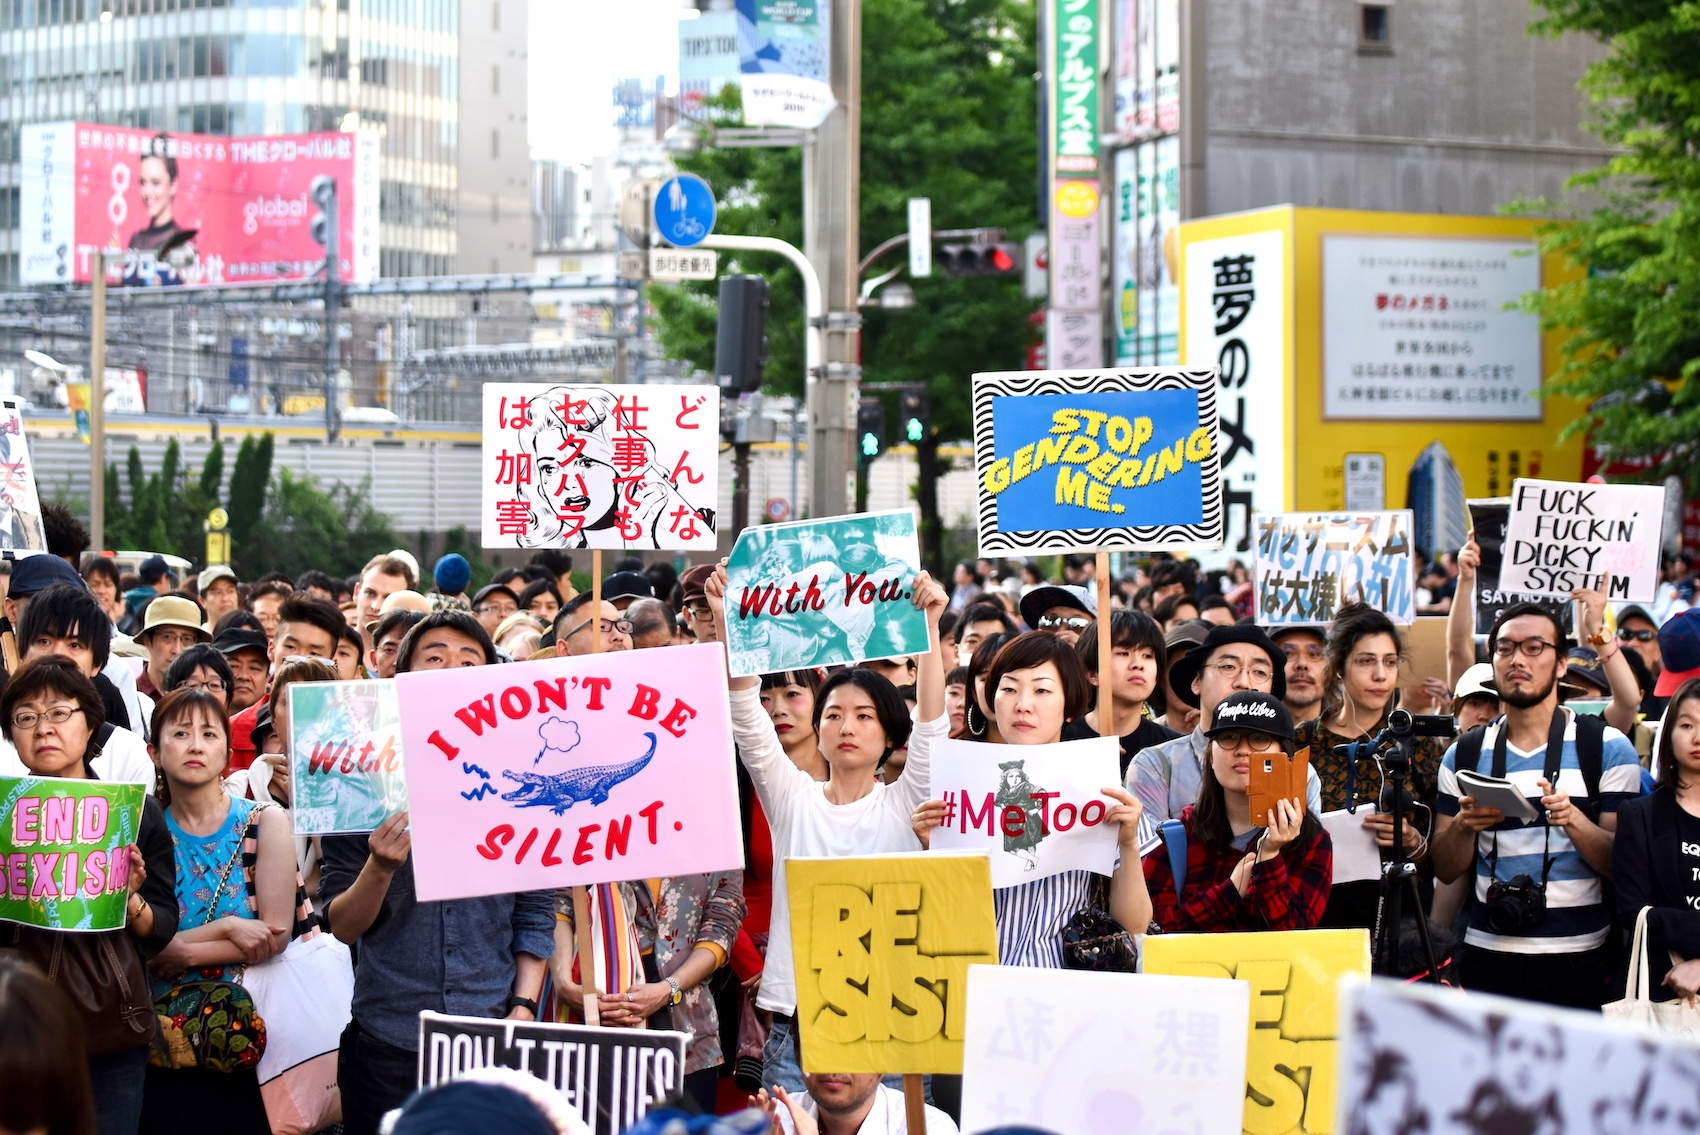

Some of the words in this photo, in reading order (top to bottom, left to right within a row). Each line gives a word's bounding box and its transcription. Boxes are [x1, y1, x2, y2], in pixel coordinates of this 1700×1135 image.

[1049, 408, 1153, 457] STOP
[495, 396, 533, 536] は加害
[554, 393, 590, 539] セクハラ
[611, 394, 649, 540] 仕事でも
[669, 395, 707, 540] どんな
[984, 426, 1212, 495] GENDERING
[1055, 465, 1126, 515] ME.
[1517, 485, 1597, 516] FUCK
[1512, 540, 1602, 572] DICKY
[739, 574, 825, 620] With
[844, 570, 911, 608] You.
[1481, 589, 1514, 604] SAY
[427, 730, 460, 761] I
[454, 675, 612, 736] WON'T
[627, 683, 697, 738] BE
[1217, 702, 1249, 721] Temps
[1249, 702, 1276, 719] libre
[308, 735, 399, 776] With
[11, 796, 109, 848] END
[476, 800, 683, 867] SILENT.
[941, 789, 1106, 838] #MeToo
[810, 881, 923, 970] RE
